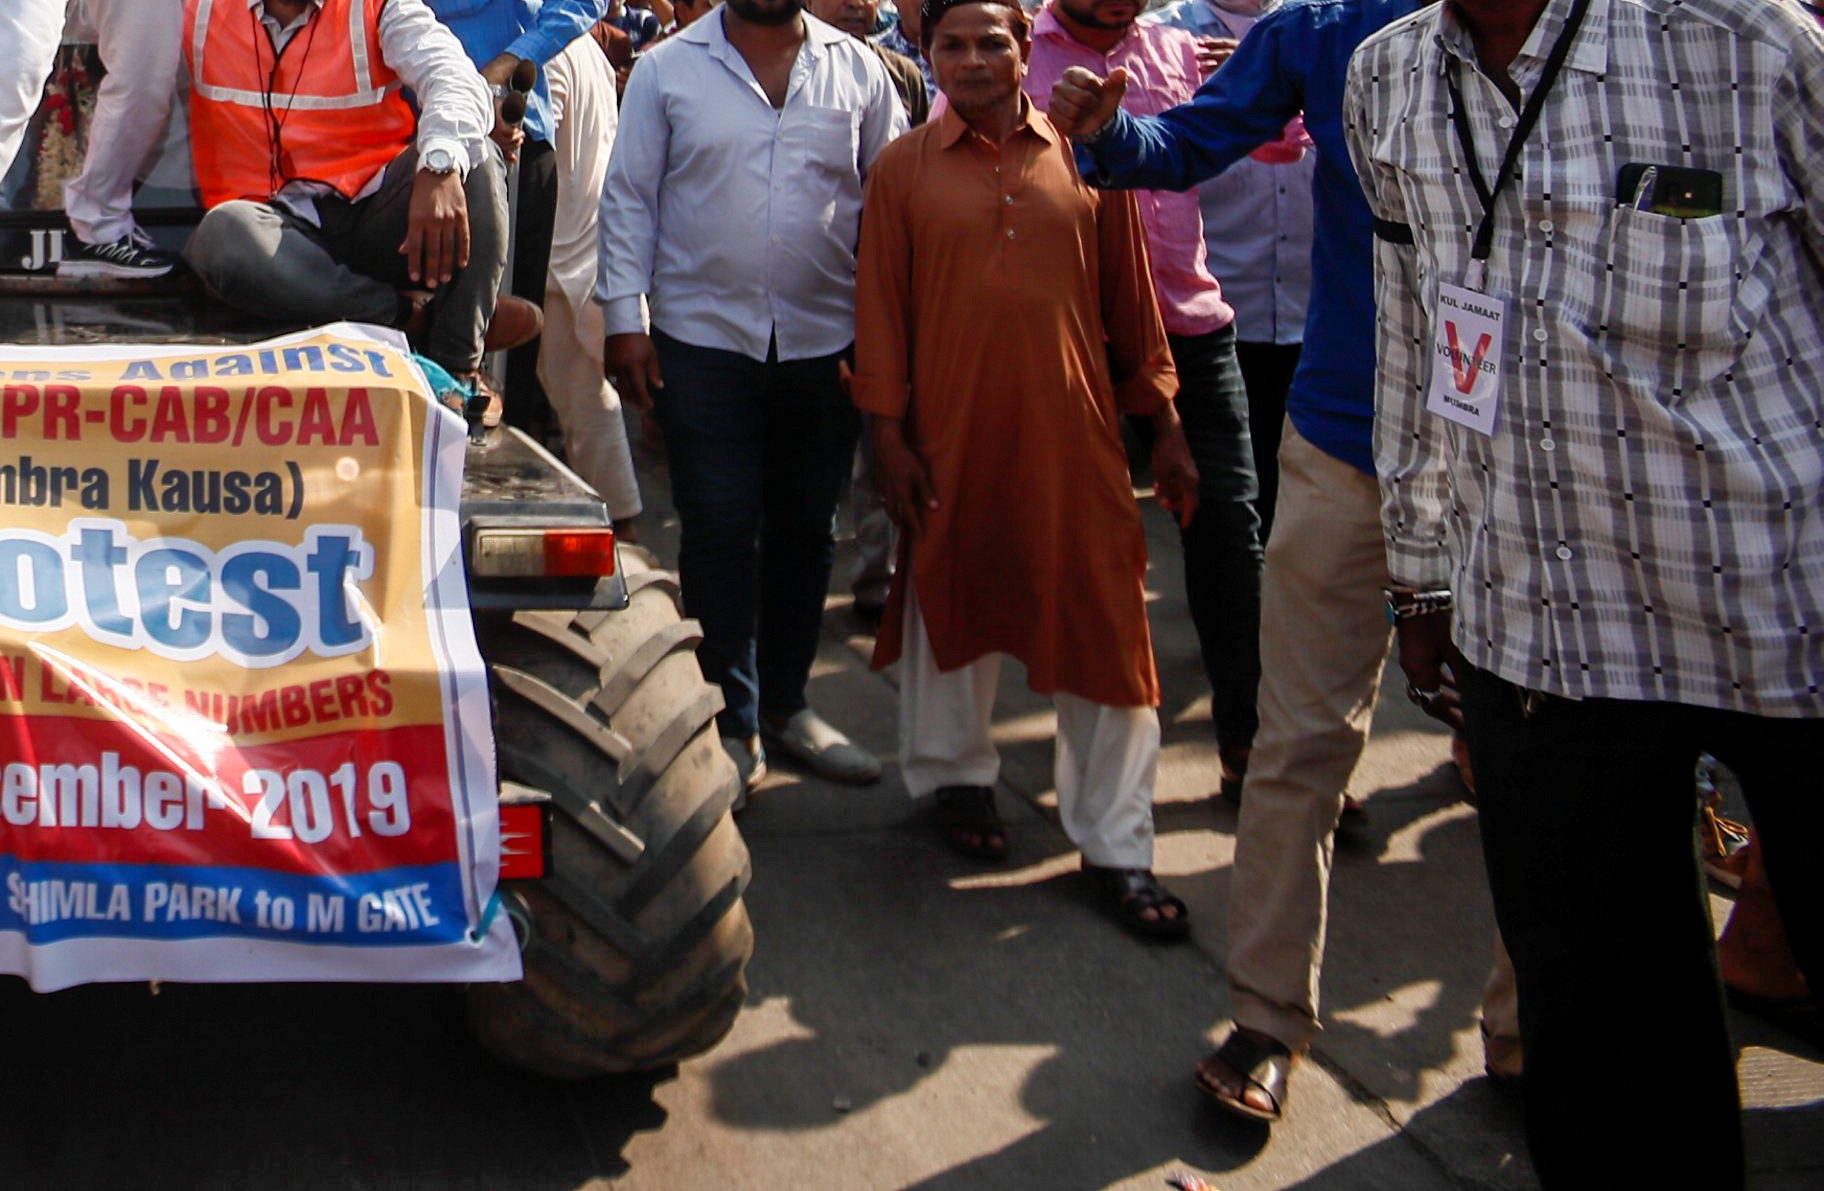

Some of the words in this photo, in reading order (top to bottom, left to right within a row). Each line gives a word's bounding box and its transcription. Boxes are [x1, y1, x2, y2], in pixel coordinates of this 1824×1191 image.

[1440, 295, 1458, 308] KUL
[1461, 301, 1500, 322] JAMAAT
[119, 343, 394, 381] Against
[1443, 394, 1480, 416] MUMBRA
[127, 458, 305, 520] Kausa)
[184, 668, 395, 737] NUMBERS
[241, 760, 412, 844] 2019
[7, 871, 131, 925] SHIMLA
[143, 882, 244, 925] PARK
[253, 889, 296, 931] to
[306, 892, 346, 933] M
[357, 882, 440, 934] GATE
